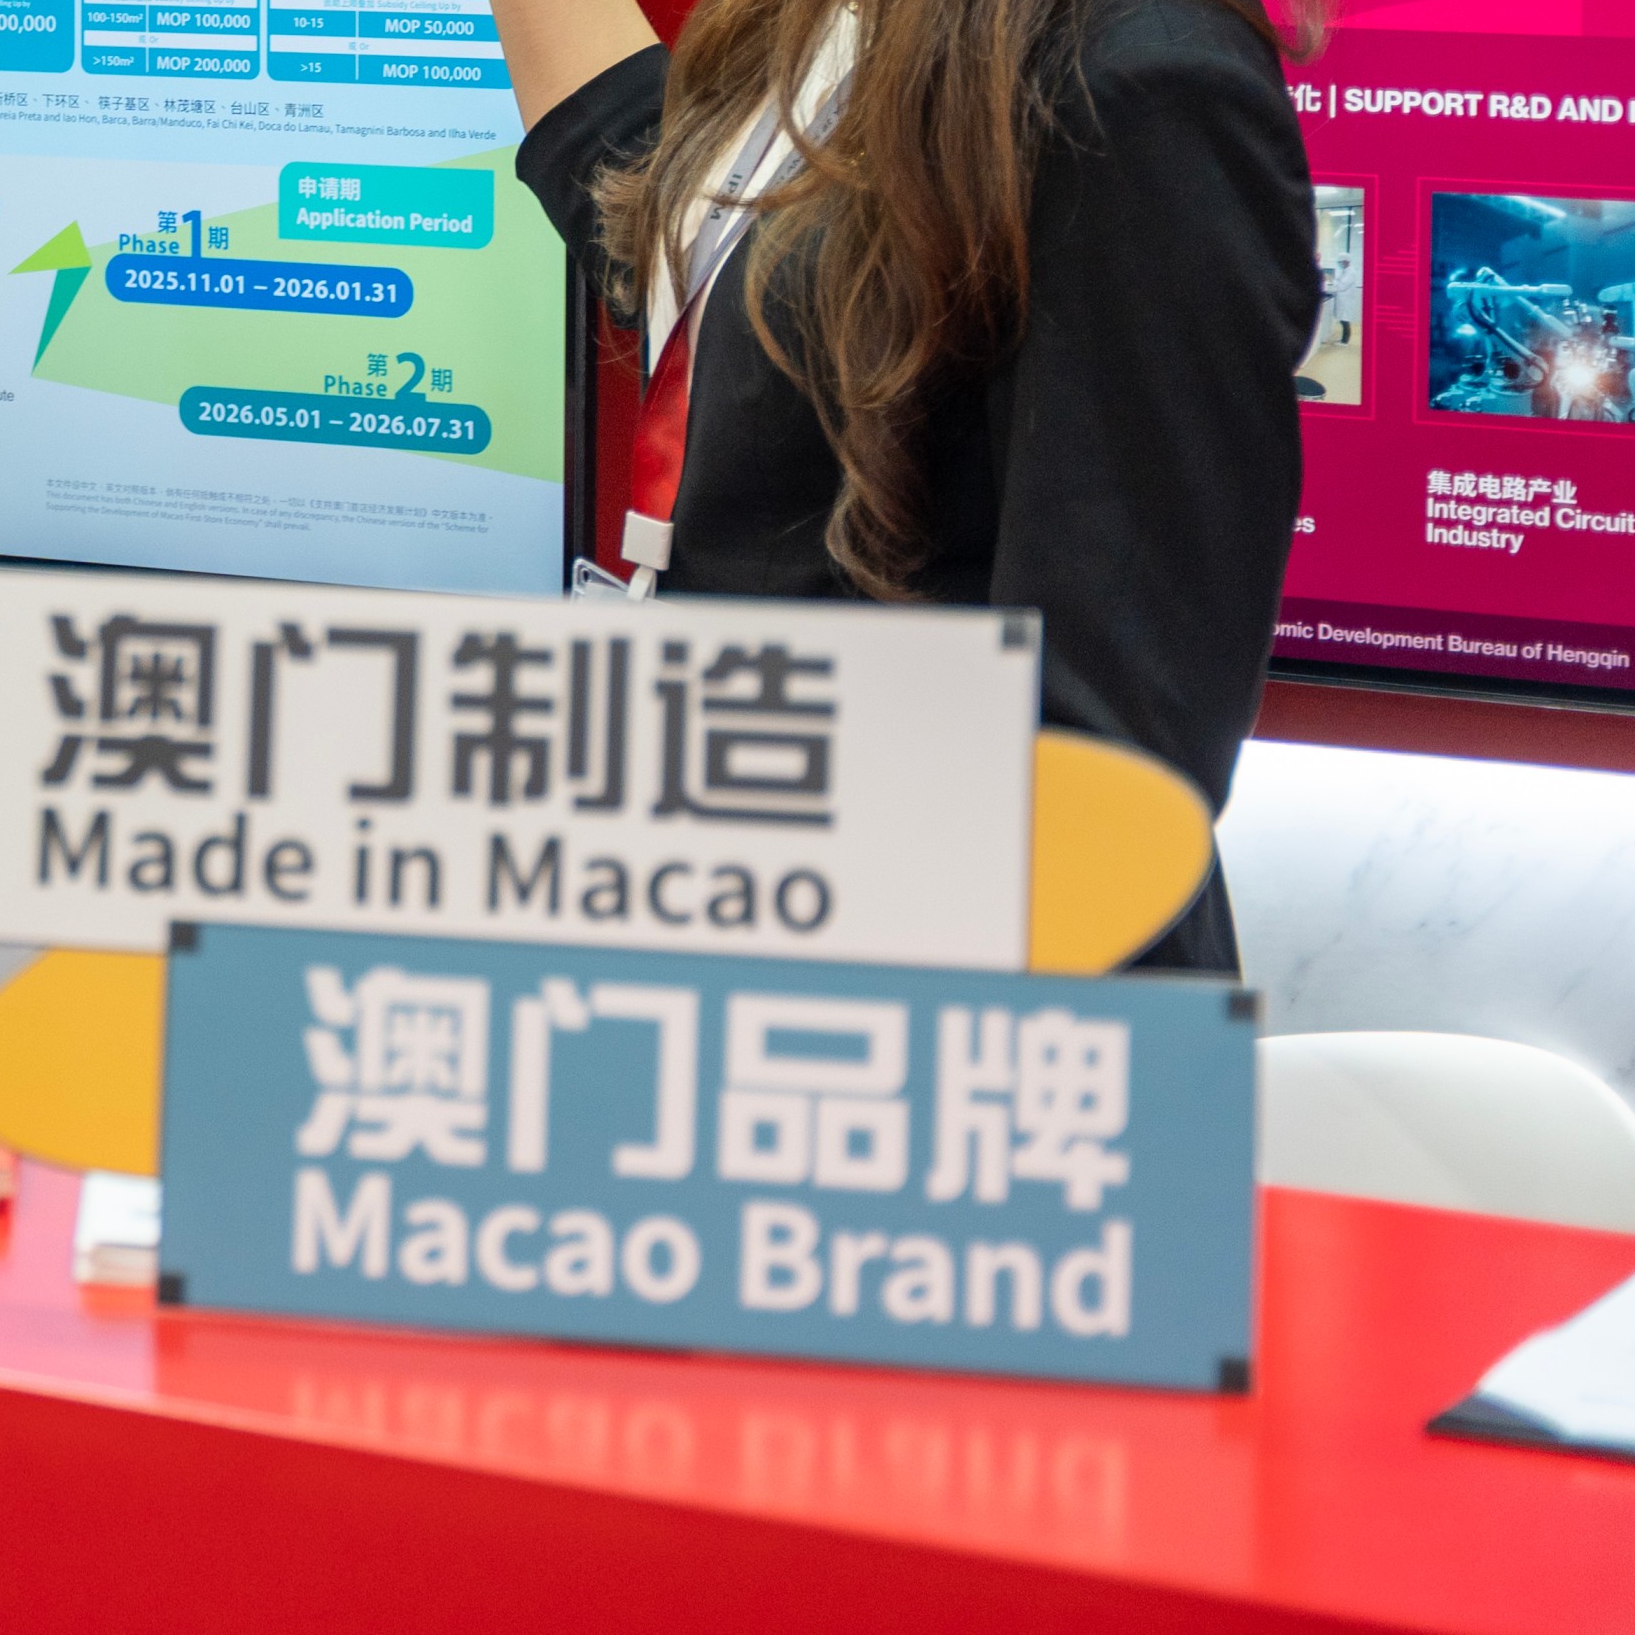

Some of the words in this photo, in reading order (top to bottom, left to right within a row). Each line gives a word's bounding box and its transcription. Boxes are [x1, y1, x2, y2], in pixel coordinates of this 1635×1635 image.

[1344, 88, 1483, 116] SUPPORT
[1489, 94, 1552, 119] R&D
[1557, 97, 1623, 122] AND
[299, 176, 360, 201] 申请期
[296, 207, 405, 230] Application
[410, 213, 472, 233] Period
[125, 269, 244, 294] 2025.11.01
[273, 277, 396, 303] 2026.01.31
[199, 402, 320, 429] 2026.05.01
[349, 412, 474, 440] 2026.07.31
[1428, 470, 1577, 505] 集成电路产业
[1427, 497, 1550, 533] Integrated
[1426, 522, 1524, 554] Industry
[1318, 623, 1443, 651] Development
[1448, 634, 1517, 657] Bureau
[1521, 643, 1543, 659] of
[1547, 644, 1630, 669] Hengqin
[39, 613, 838, 830] 澳门制造
[36, 805, 315, 903] Made
[353, 823, 443, 909] in
[486, 832, 834, 935] Macao
[296, 966, 1130, 1210] 澳门品牌
[292, 1167, 700, 1302] Macao
[740, 1200, 1132, 1336] Brand
